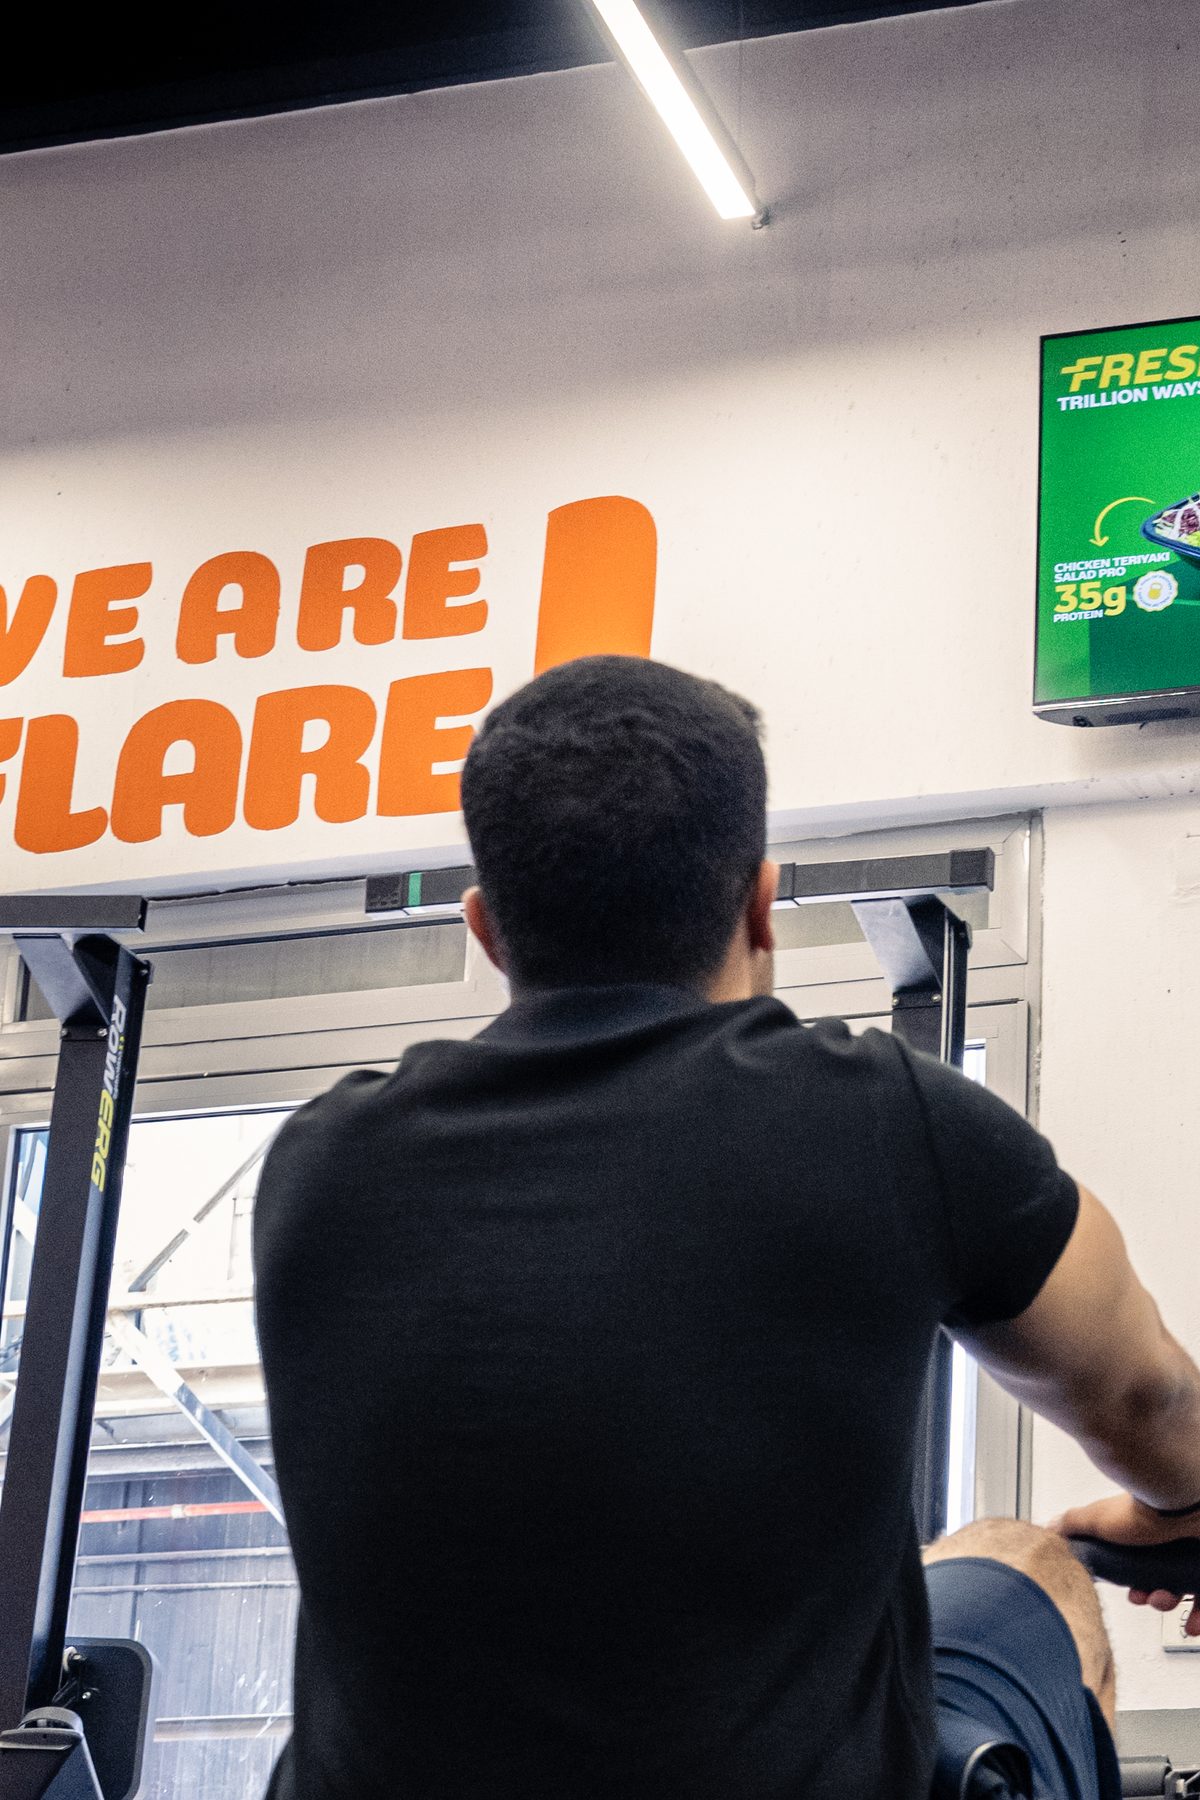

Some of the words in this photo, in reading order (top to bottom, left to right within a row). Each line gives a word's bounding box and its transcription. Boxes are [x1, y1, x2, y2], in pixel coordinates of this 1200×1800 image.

[1057, 387, 1148, 411] TRILLION
[1054, 557, 1111, 573] CHICKEN
[1112, 552, 1170, 567] TERIYAKI
[1054, 569, 1097, 583] SALAD
[1098, 567, 1126, 579] PRO
[176, 523, 488, 664] ARE
[1054, 582, 1126, 616] 35g
[1054, 610, 1103, 623] PROTEIN
[0, 667, 493, 853] LARE
